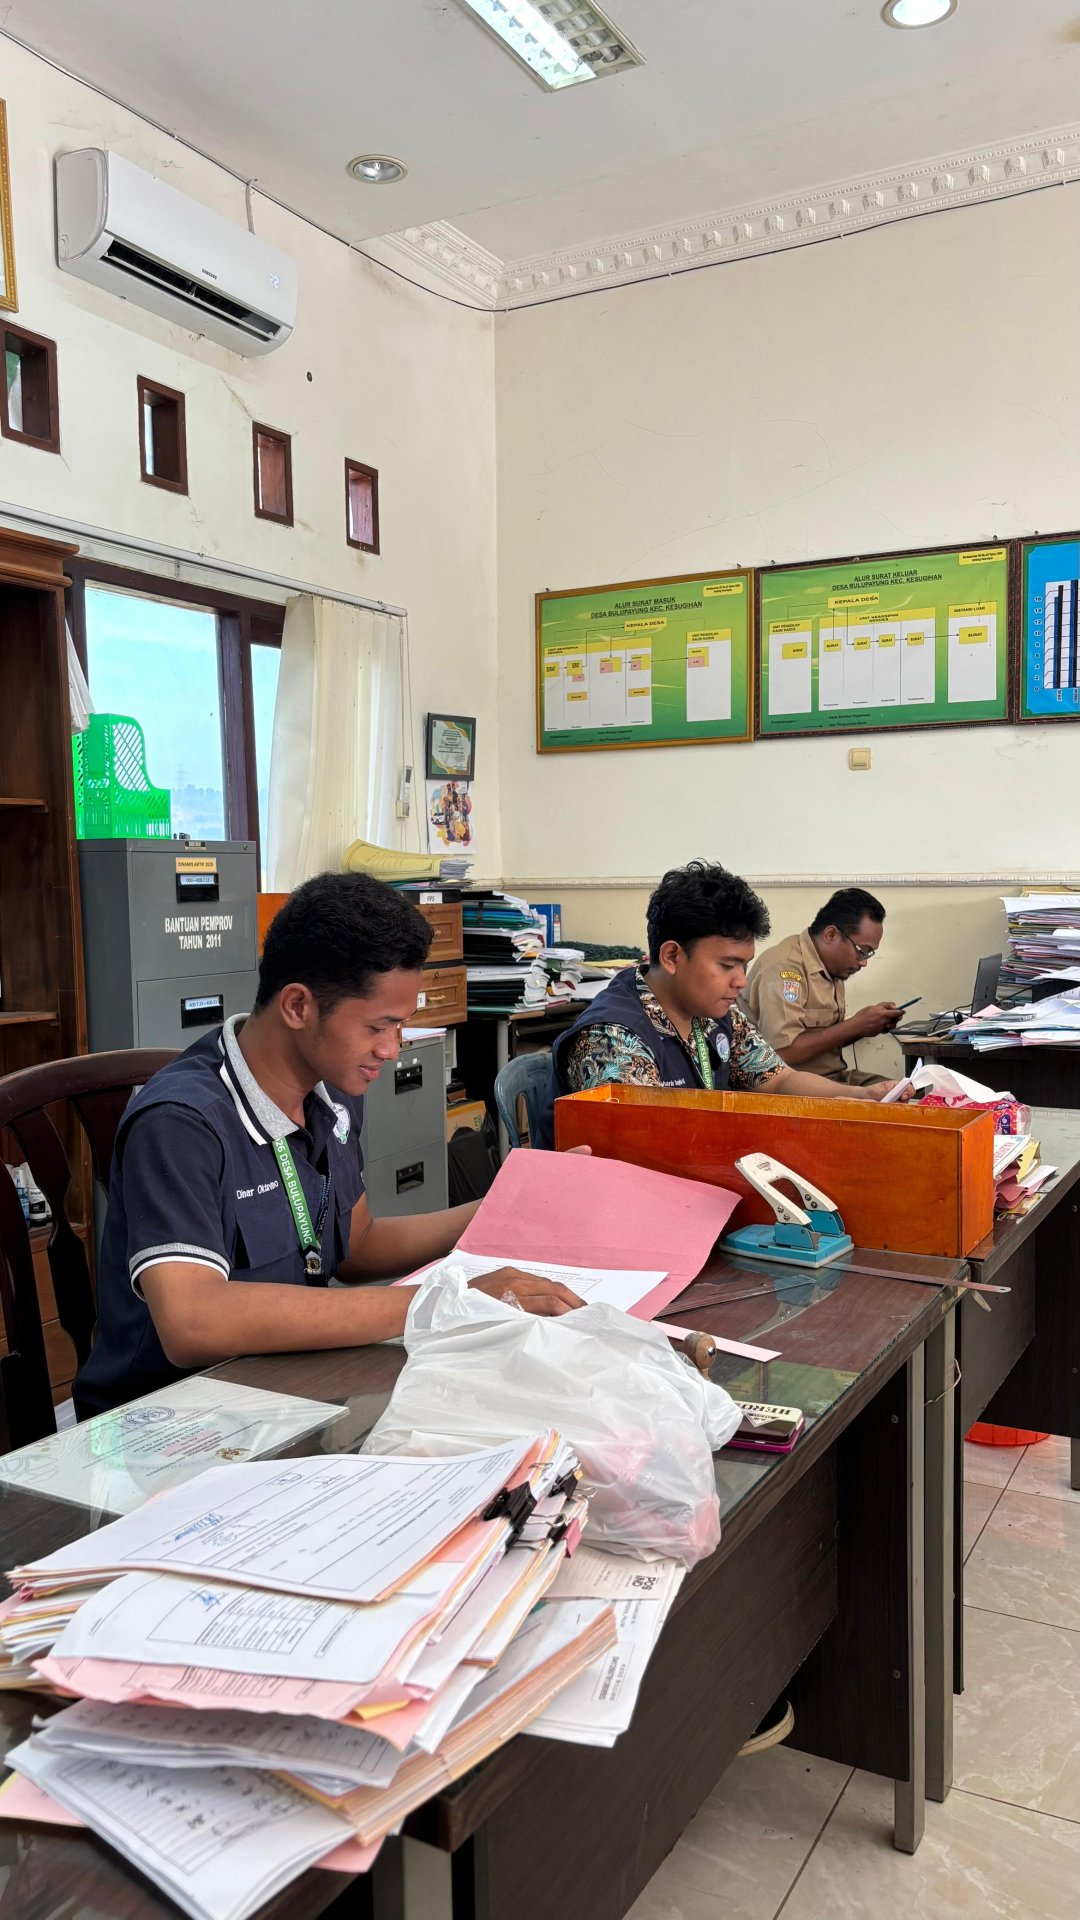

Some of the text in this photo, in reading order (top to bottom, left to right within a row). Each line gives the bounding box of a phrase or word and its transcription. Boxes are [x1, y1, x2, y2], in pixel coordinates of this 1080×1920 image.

[850, 580, 889, 590] BULUPAYUNG
[906, 574, 943, 583] KESUGIHAN
[893, 570, 917, 578] KELUAR
[608, 606, 648, 617] BULUPAYUNG
[666, 601, 703, 611] KESUGIHAN
[632, 599, 652, 607] SURAT
[654, 597, 676, 605] MASUK
[164, 915, 233, 933] BANTUAN PEMPROV
[179, 934, 222, 950] TAHUN 2011
[698, 1043, 707, 1061] DESA
[236, 1188, 255, 1200] Dinar
[279, 1153, 294, 1180] DESA
[287, 1181, 313, 1245] BULUPAYUNG
